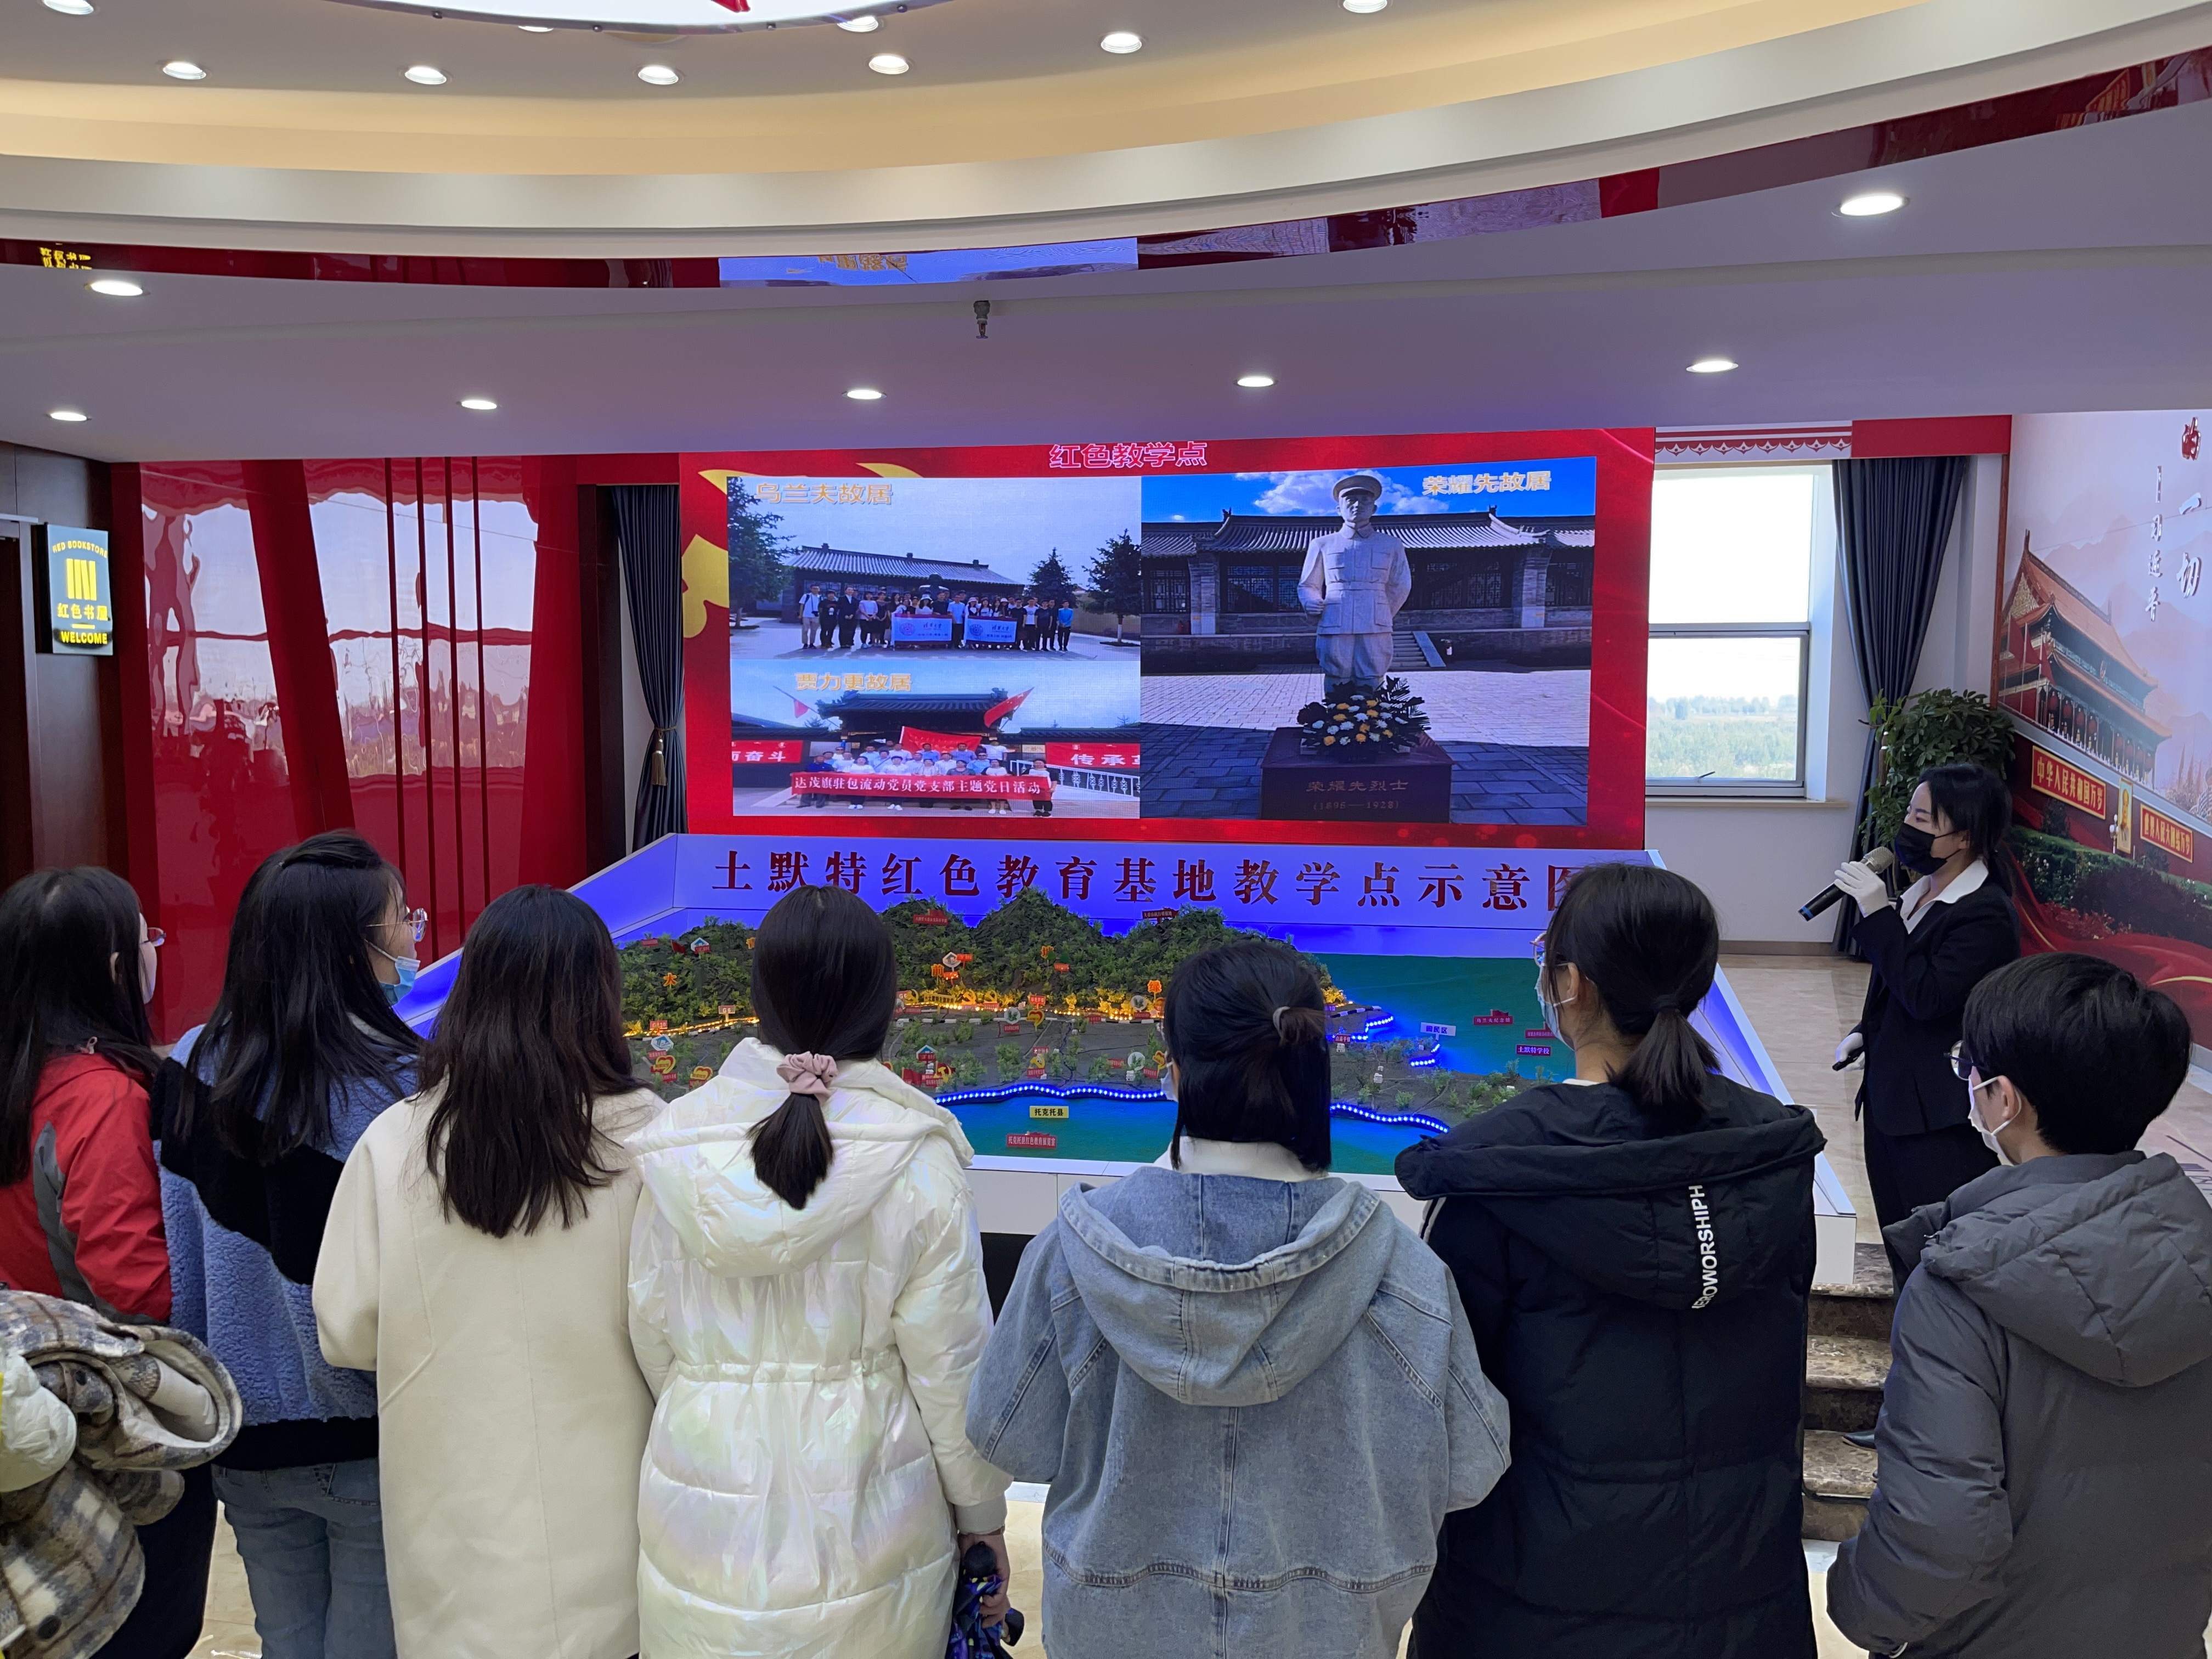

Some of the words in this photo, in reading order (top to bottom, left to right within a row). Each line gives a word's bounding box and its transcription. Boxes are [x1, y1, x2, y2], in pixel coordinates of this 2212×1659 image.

[1049, 441, 1207, 469] 红色教学点
[1422, 471, 1551, 495] 荣耀先故居
[754, 483, 893, 505] 乌兰夫故居
[53, 542, 66, 553] RED
[67, 540, 108, 558] BOOKSTORE
[57, 602, 108, 621] 红色书屋
[60, 631, 108, 645] WELCOME
[796, 673, 912, 691] 贾力更故居
[795, 776, 1041, 794] 达茂旗驻包流动党员党支部主题党日活动
[1306, 780, 1408, 792] 荣耀先烈士
[2036, 757, 2103, 811] 中华人民共和国万岁
[2144, 812, 2191, 855] 世界人民大团结万岁
[663, 973, 678, 987] 大
[1426, 1025, 1448, 1034] 回民区
[1517, 1046, 1550, 1054] 土默特学校
[1034, 1108, 1063, 1116] 托克托县
